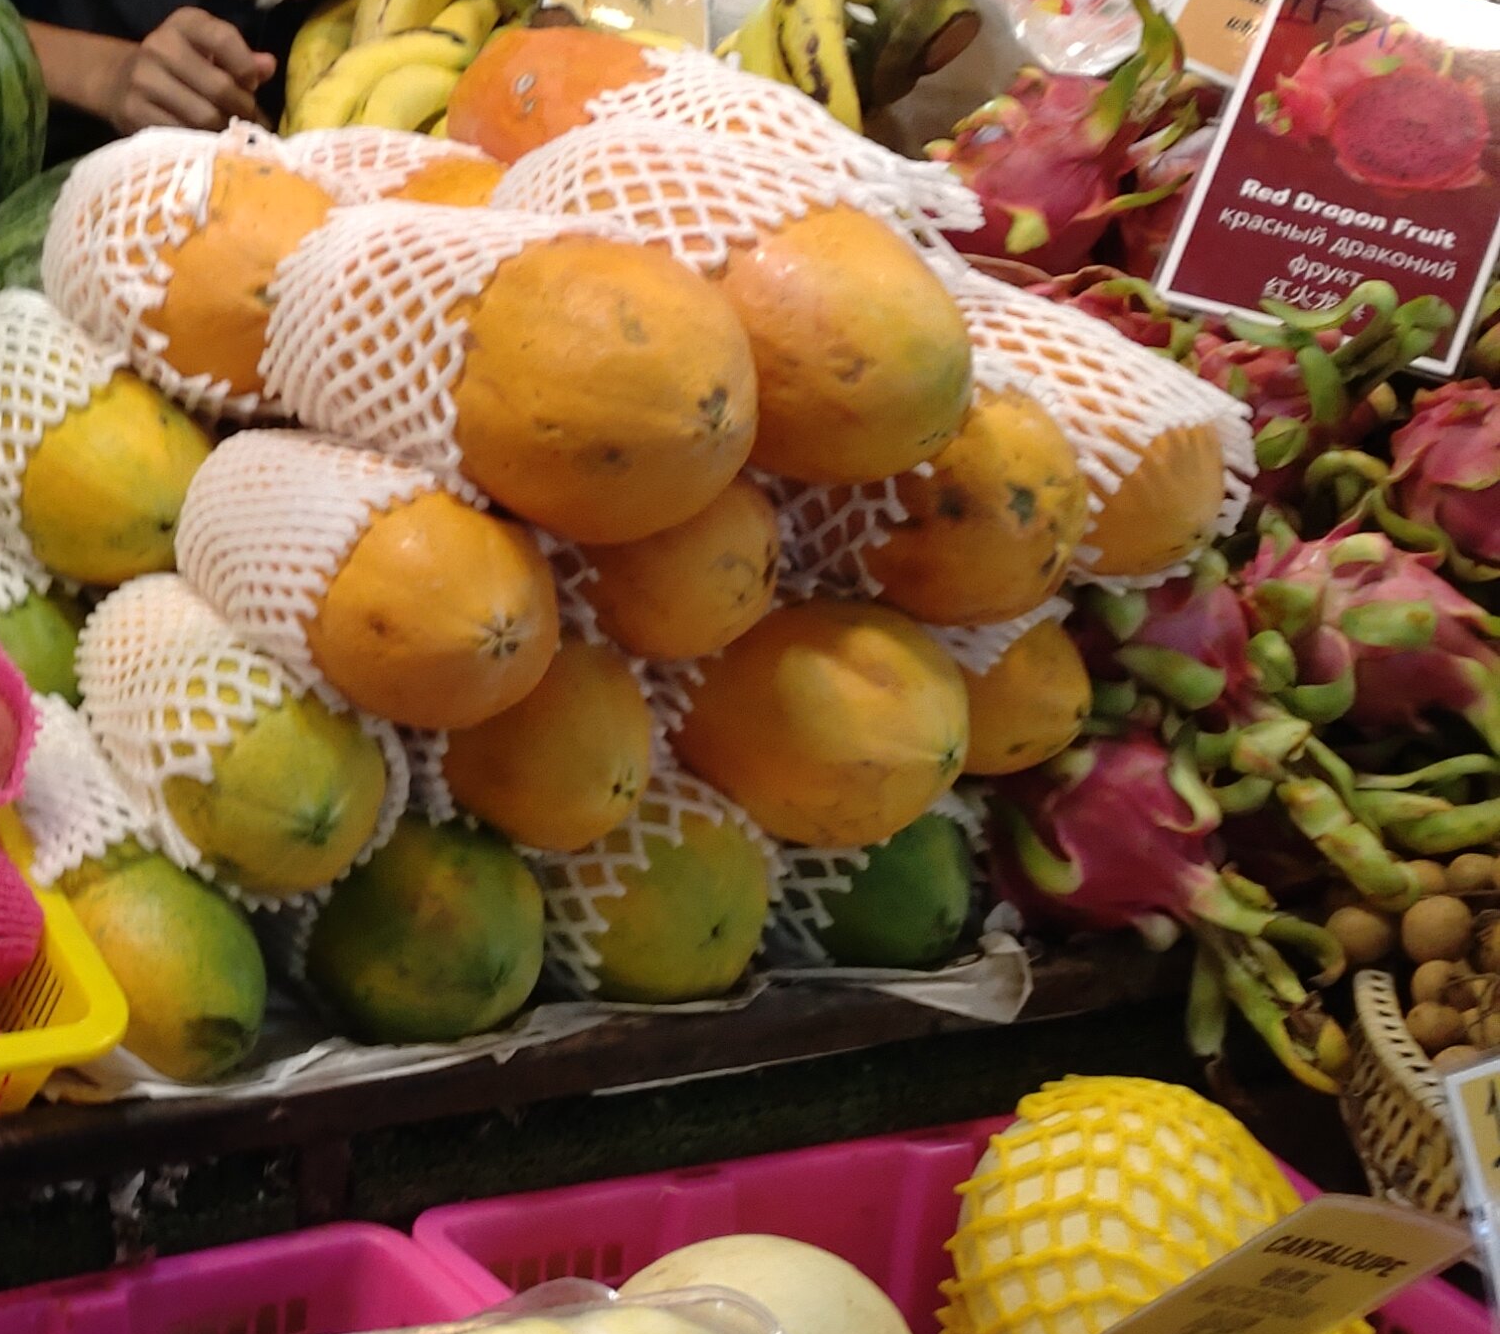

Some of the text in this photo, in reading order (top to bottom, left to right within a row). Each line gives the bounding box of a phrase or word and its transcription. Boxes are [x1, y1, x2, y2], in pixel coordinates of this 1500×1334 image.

[1238, 177, 1457, 251] Red Dragon Fruit
[1217, 206, 1458, 282] красный драконий
[1286, 253, 1365, 288] фрукт
[1262, 1234, 1409, 1279] CANTALOUPE
